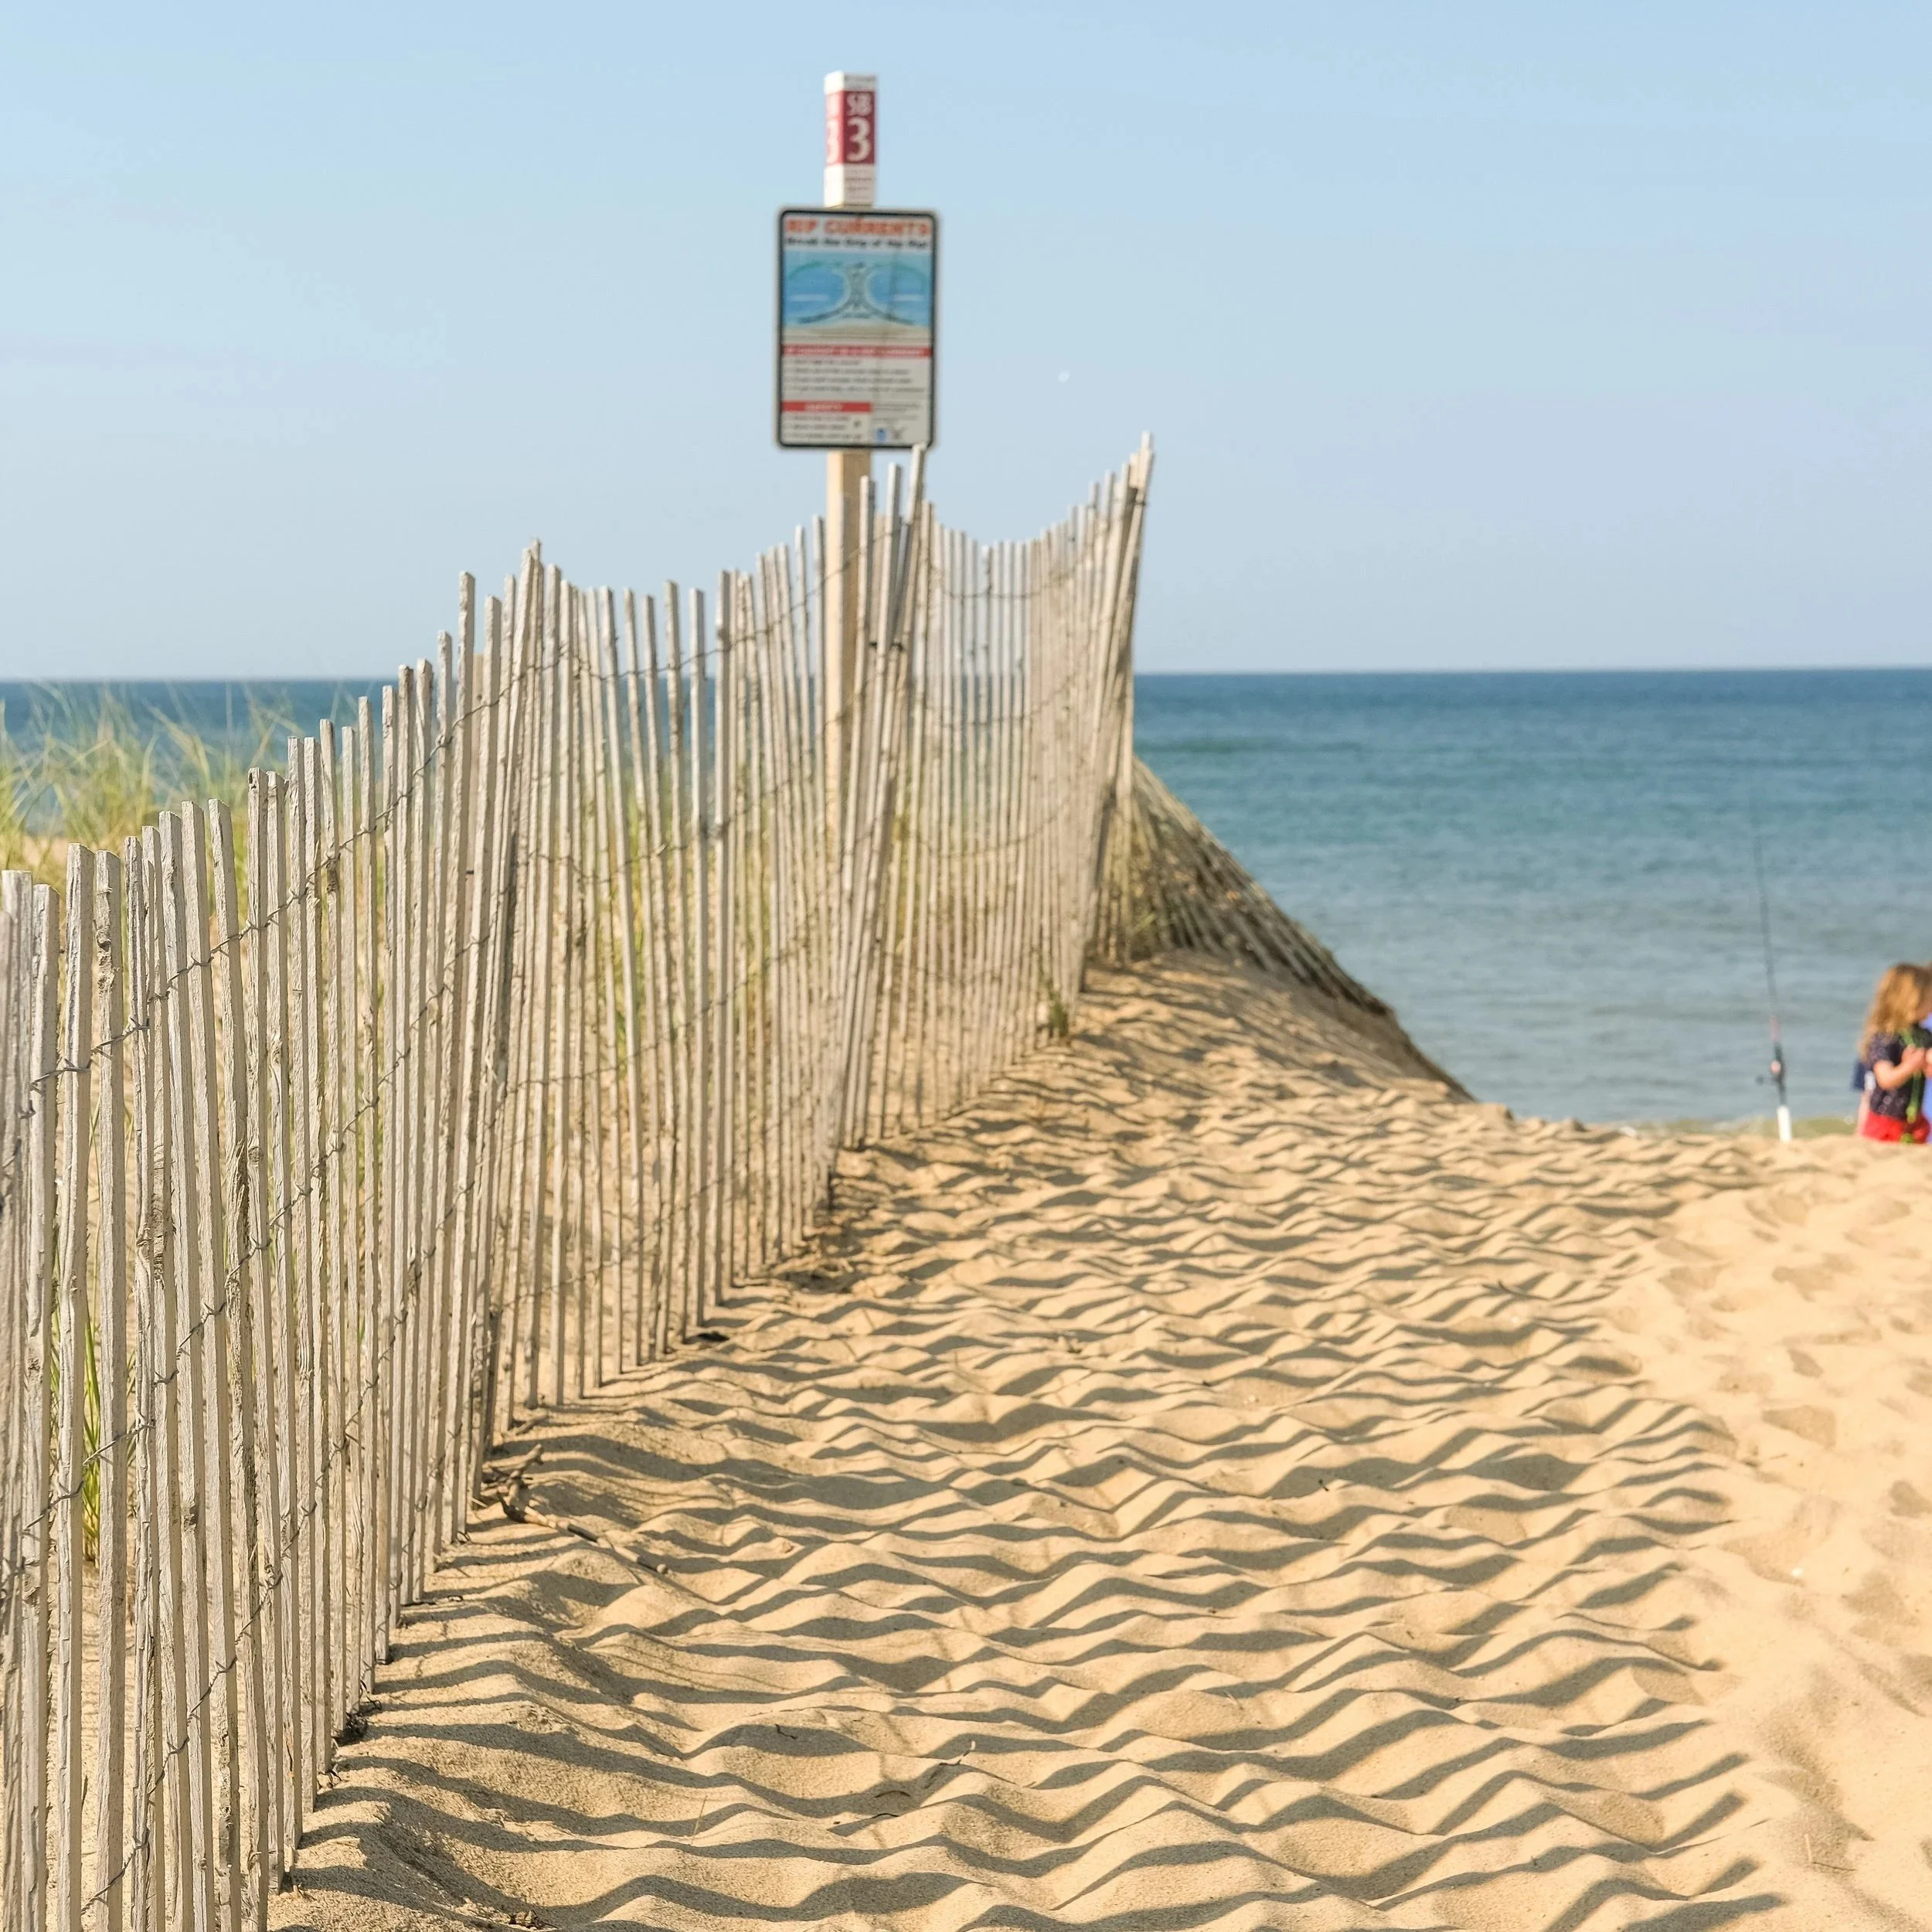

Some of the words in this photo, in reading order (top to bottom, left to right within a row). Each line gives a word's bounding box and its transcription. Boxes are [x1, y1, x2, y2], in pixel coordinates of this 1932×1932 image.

[846, 117, 870, 162] 3
[787, 219, 817, 233] RIP
[825, 219, 930, 236] CURRENTS
